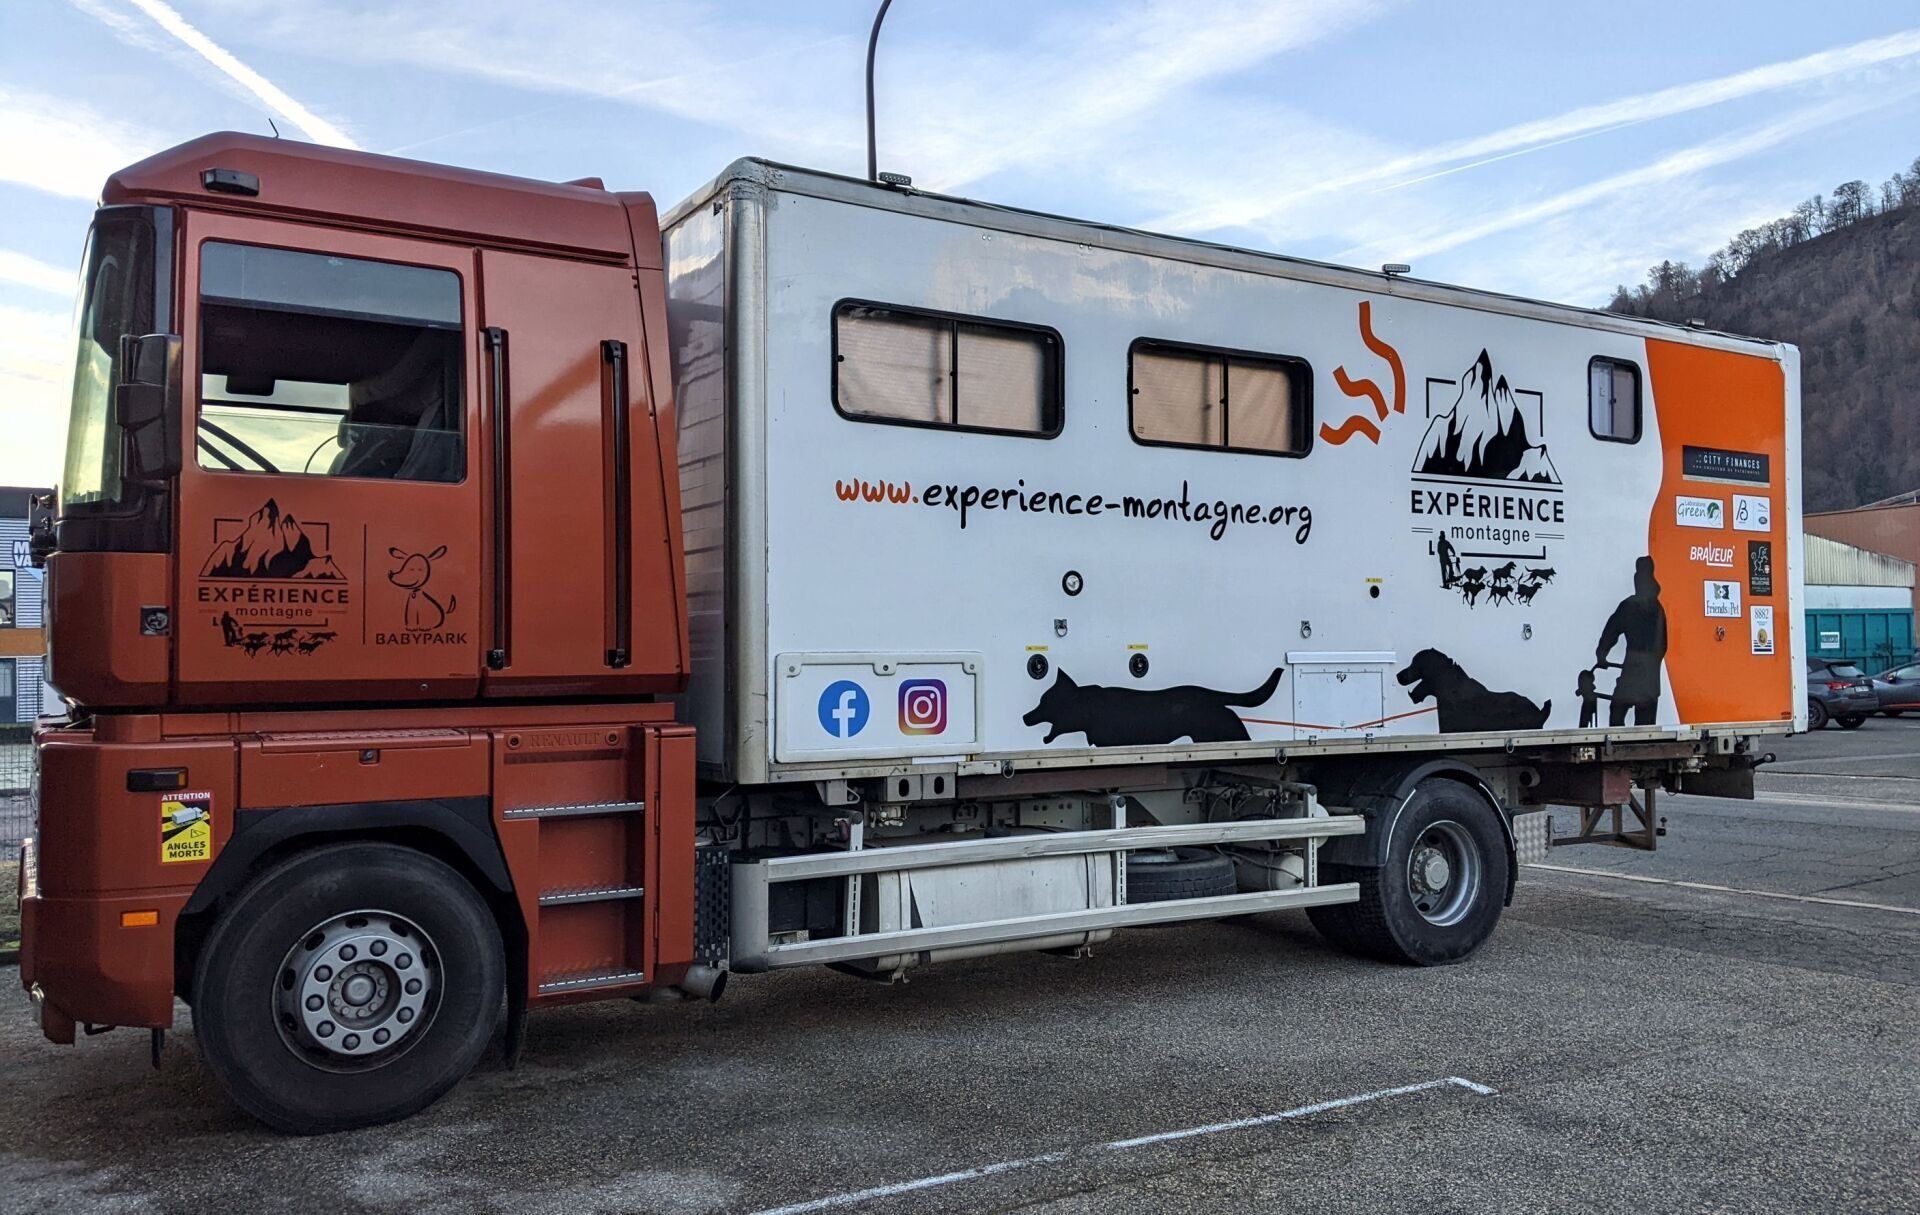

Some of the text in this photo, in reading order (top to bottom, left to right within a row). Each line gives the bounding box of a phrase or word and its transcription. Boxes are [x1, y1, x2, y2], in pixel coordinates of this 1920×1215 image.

[1703, 454, 1760, 470] CITY FINANCES
[835, 478, 1312, 544] www.experience-montagne.org
[1411, 488, 1565, 523] EXPÉRIENCE
[1677, 503, 1706, 518] Green
[1451, 525, 1530, 546] montagne
[1690, 542, 1733, 564] BRAVEUR
[198, 584, 349, 604] EXPÉRIENCE
[235, 605, 313, 619] montagne
[1706, 600, 1740, 616] Friends Pet
[375, 632, 467, 645] BABYPARK
[529, 731, 600, 748] RENAULT
[162, 792, 211, 801] ATTENTION
[167, 841, 206, 851] ANGLES
[169, 849, 204, 859] MORTS
